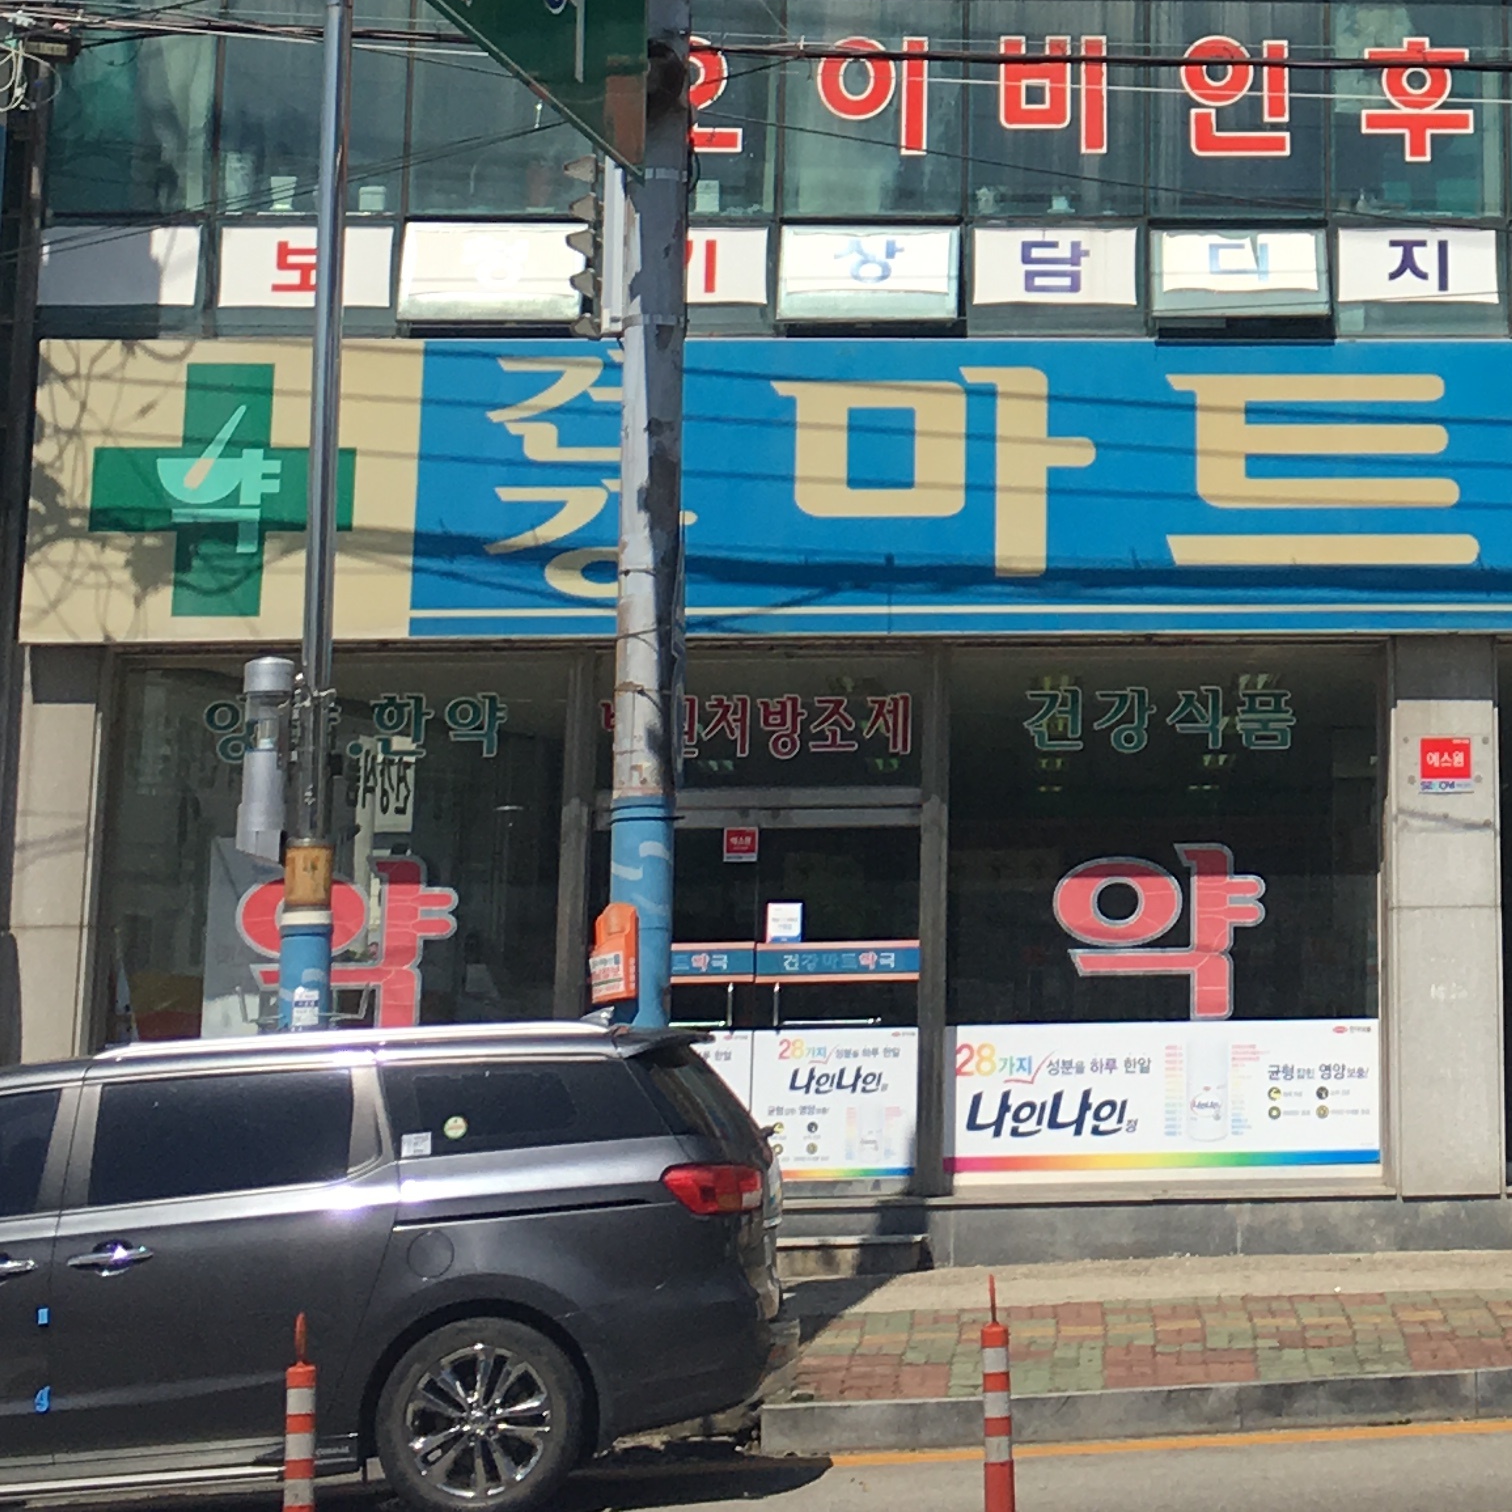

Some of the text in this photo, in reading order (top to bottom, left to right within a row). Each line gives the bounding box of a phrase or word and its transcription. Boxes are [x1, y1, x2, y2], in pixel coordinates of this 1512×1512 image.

[601, 693, 912, 760] 처방조제
[1024, 684, 1297, 754] 건강식품
[1053, 842, 1266, 1021] 약
[1090, 1057, 1118, 1075] 하루
